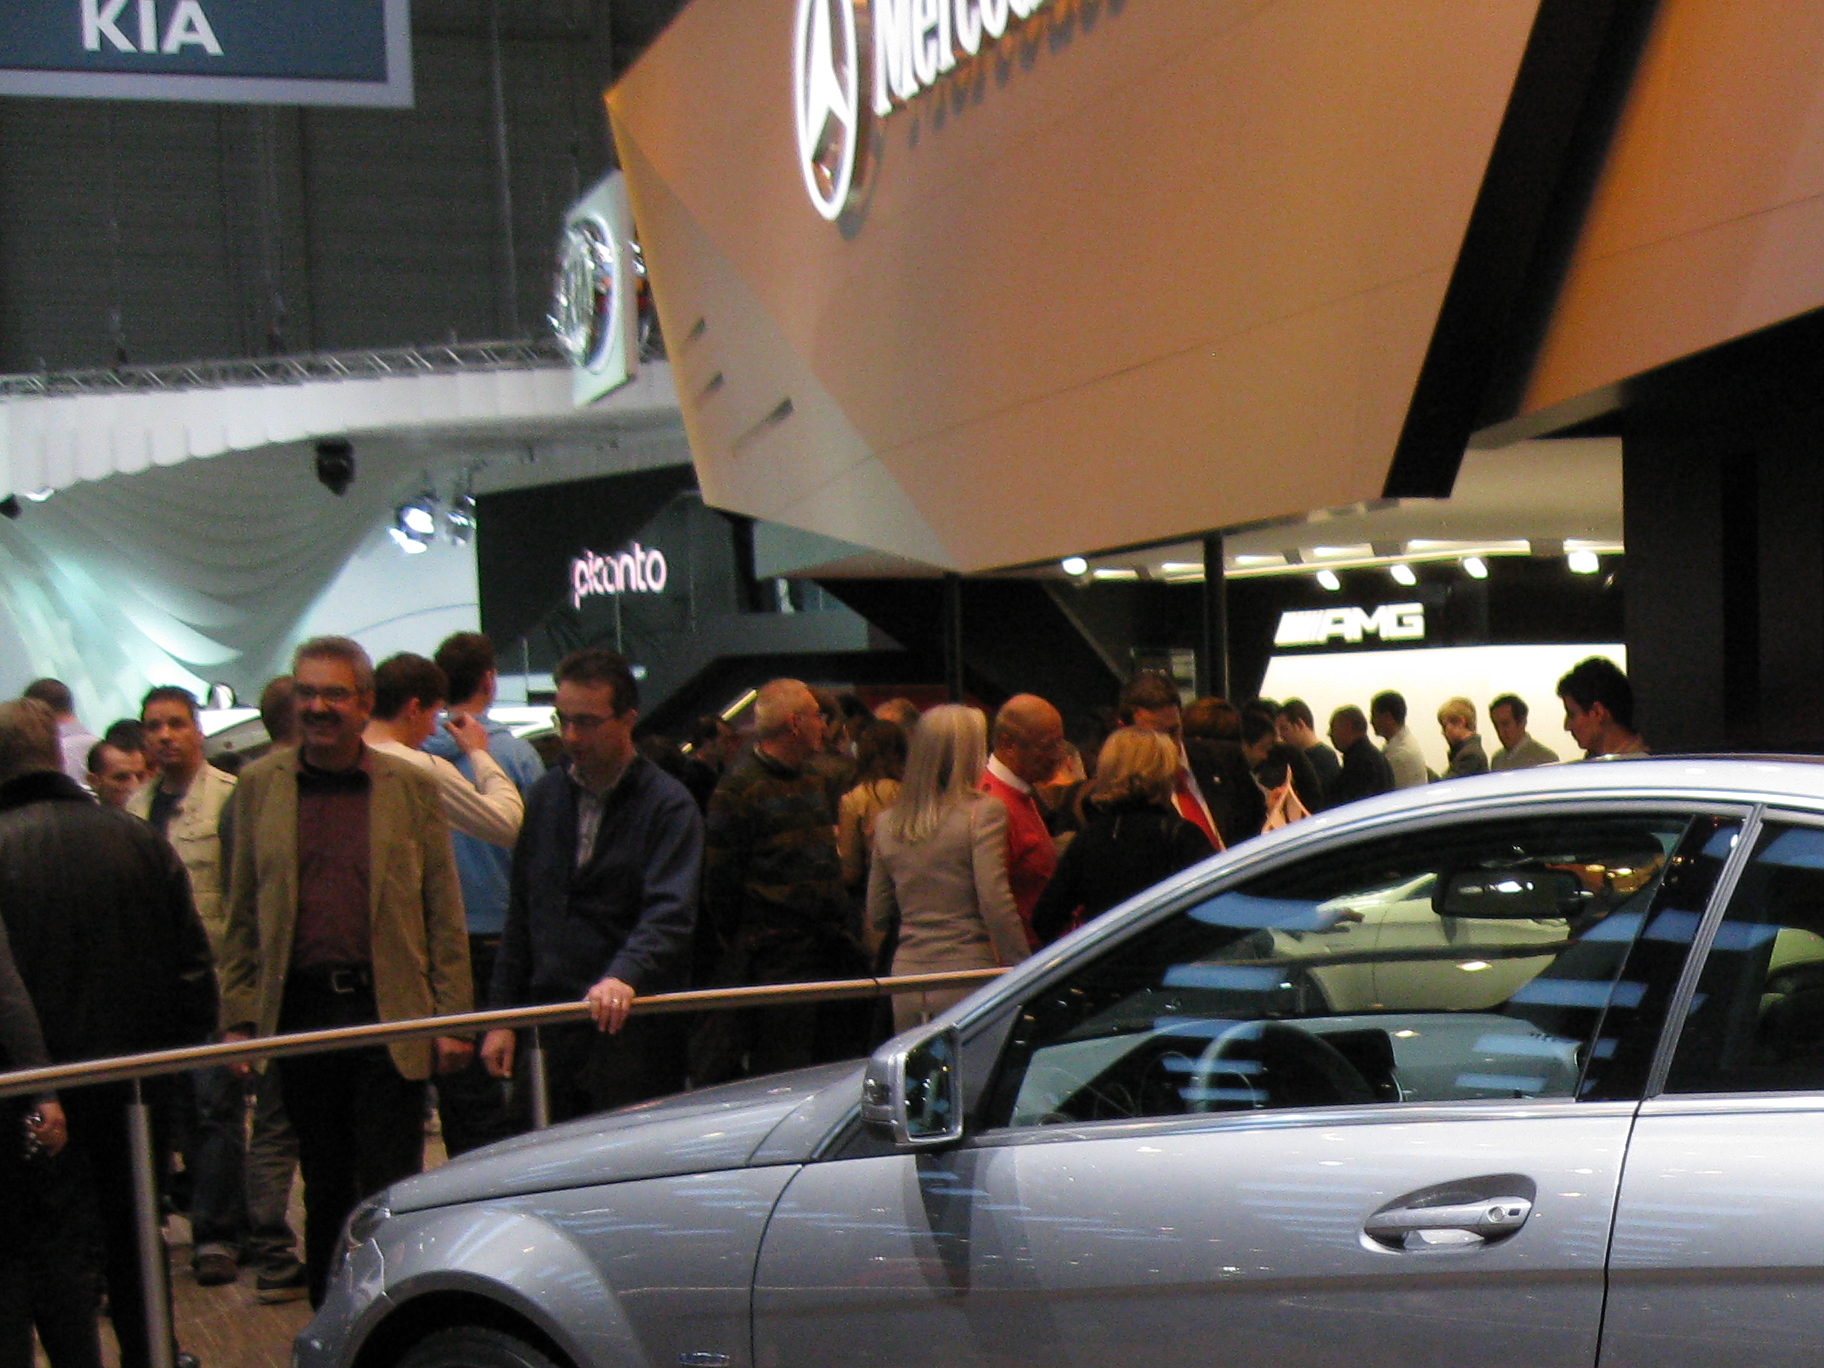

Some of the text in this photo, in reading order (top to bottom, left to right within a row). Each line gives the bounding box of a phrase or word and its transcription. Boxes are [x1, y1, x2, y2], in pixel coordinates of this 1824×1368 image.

[80, 0, 225, 56] KIA
[573, 541, 667, 610] picanto
[1317, 602, 1425, 644] AMG
